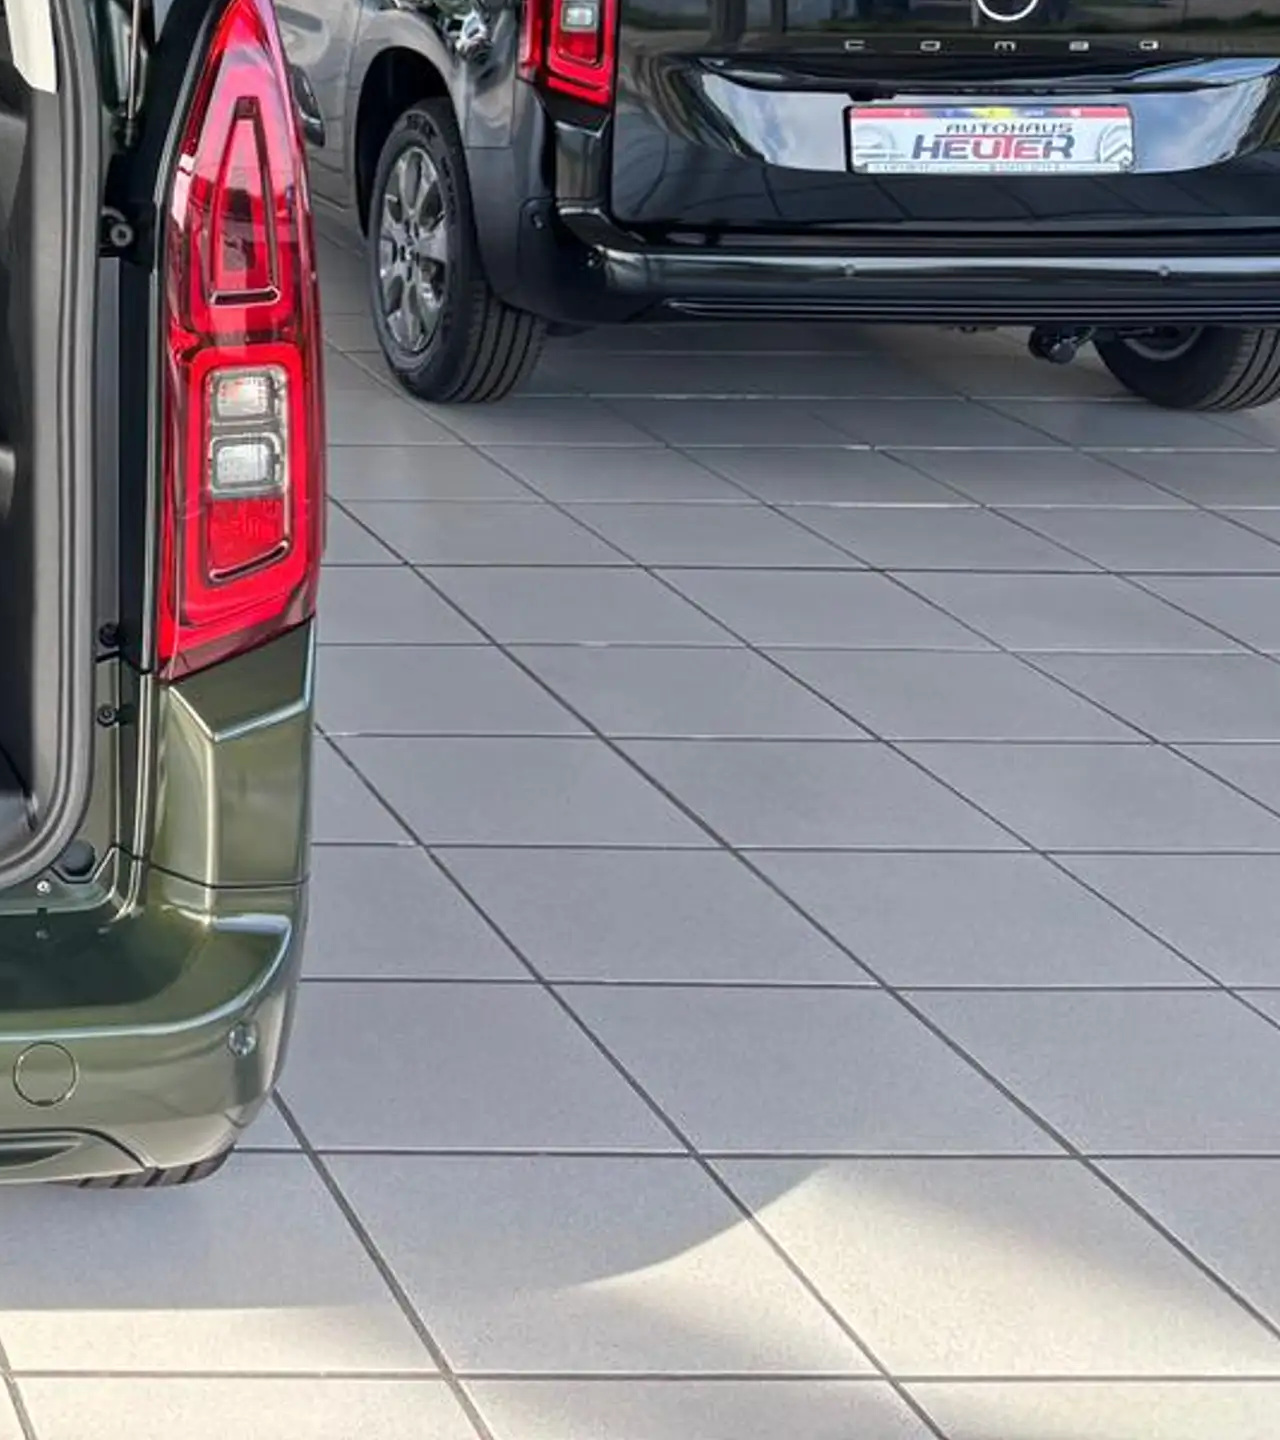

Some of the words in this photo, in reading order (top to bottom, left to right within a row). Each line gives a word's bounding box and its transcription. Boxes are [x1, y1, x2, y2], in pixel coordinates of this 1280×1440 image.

[844, 39, 1160, 52] COMBO
[945, 121, 1074, 134] AUTOHAUS
[911, 133, 1077, 160] HEUTER
